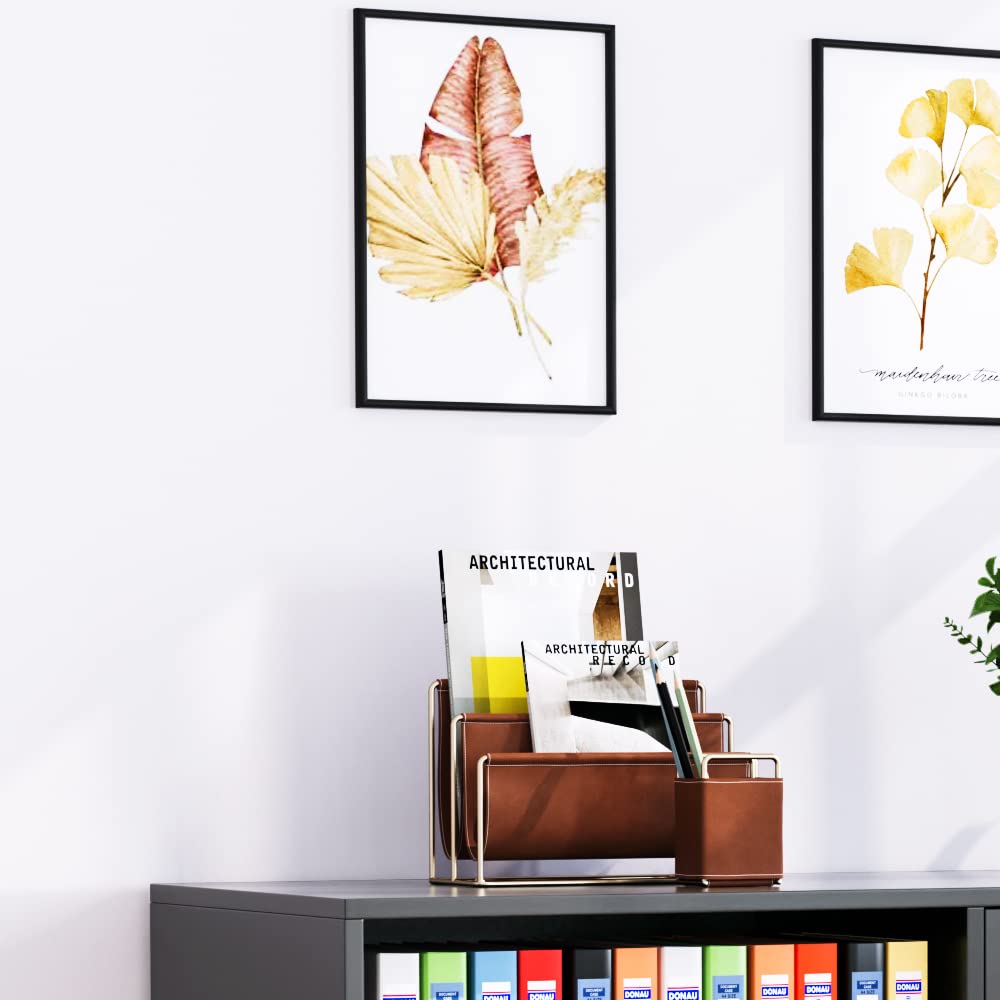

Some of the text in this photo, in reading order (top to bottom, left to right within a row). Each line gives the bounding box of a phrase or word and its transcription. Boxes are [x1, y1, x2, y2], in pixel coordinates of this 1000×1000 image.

[469, 554, 596, 571] ARCHITECTURAL
[545, 643, 645, 655] ARCHITECTURAL
[592, 655, 676, 666] RECOD
[806, 985, 830, 994] DONAU
[896, 983, 920, 991] DONAU
[530, 993, 555, 1000] DONAU
[624, 990, 650, 999] DONAU
[668, 992, 698, 1000] DONAU
[763, 988, 787, 996] DONAU
